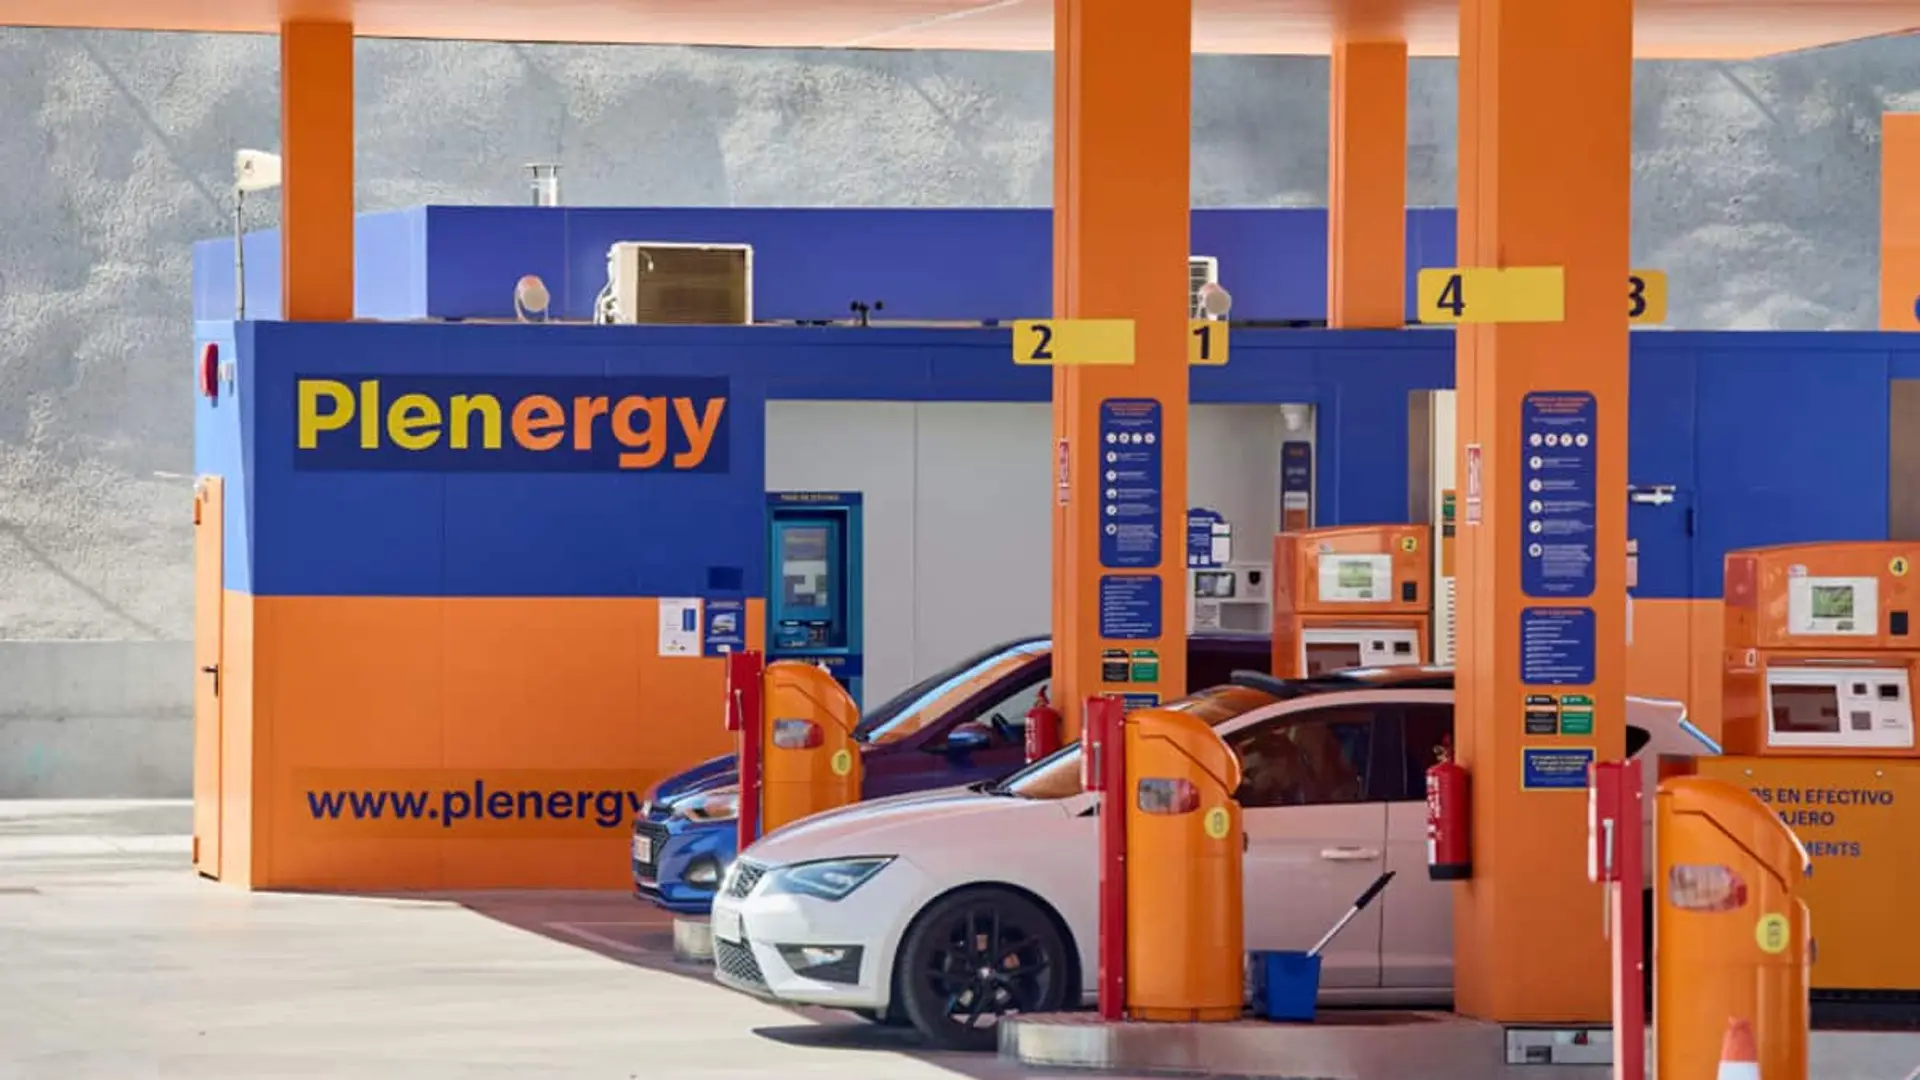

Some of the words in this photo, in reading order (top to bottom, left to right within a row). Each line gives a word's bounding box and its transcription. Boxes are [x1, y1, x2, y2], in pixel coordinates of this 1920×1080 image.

[1436, 274, 1465, 317] 4
[1628, 276, 1646, 318] 3
[1030, 324, 1053, 360] 2
[1192, 325, 1211, 360] 1
[296, 378, 727, 470] Plenergy
[1405, 538, 1414, 550] 2
[1893, 559, 1904, 574] 4
[1777, 788, 1801, 804] EN
[1805, 789, 1894, 805] EFECTIVO
